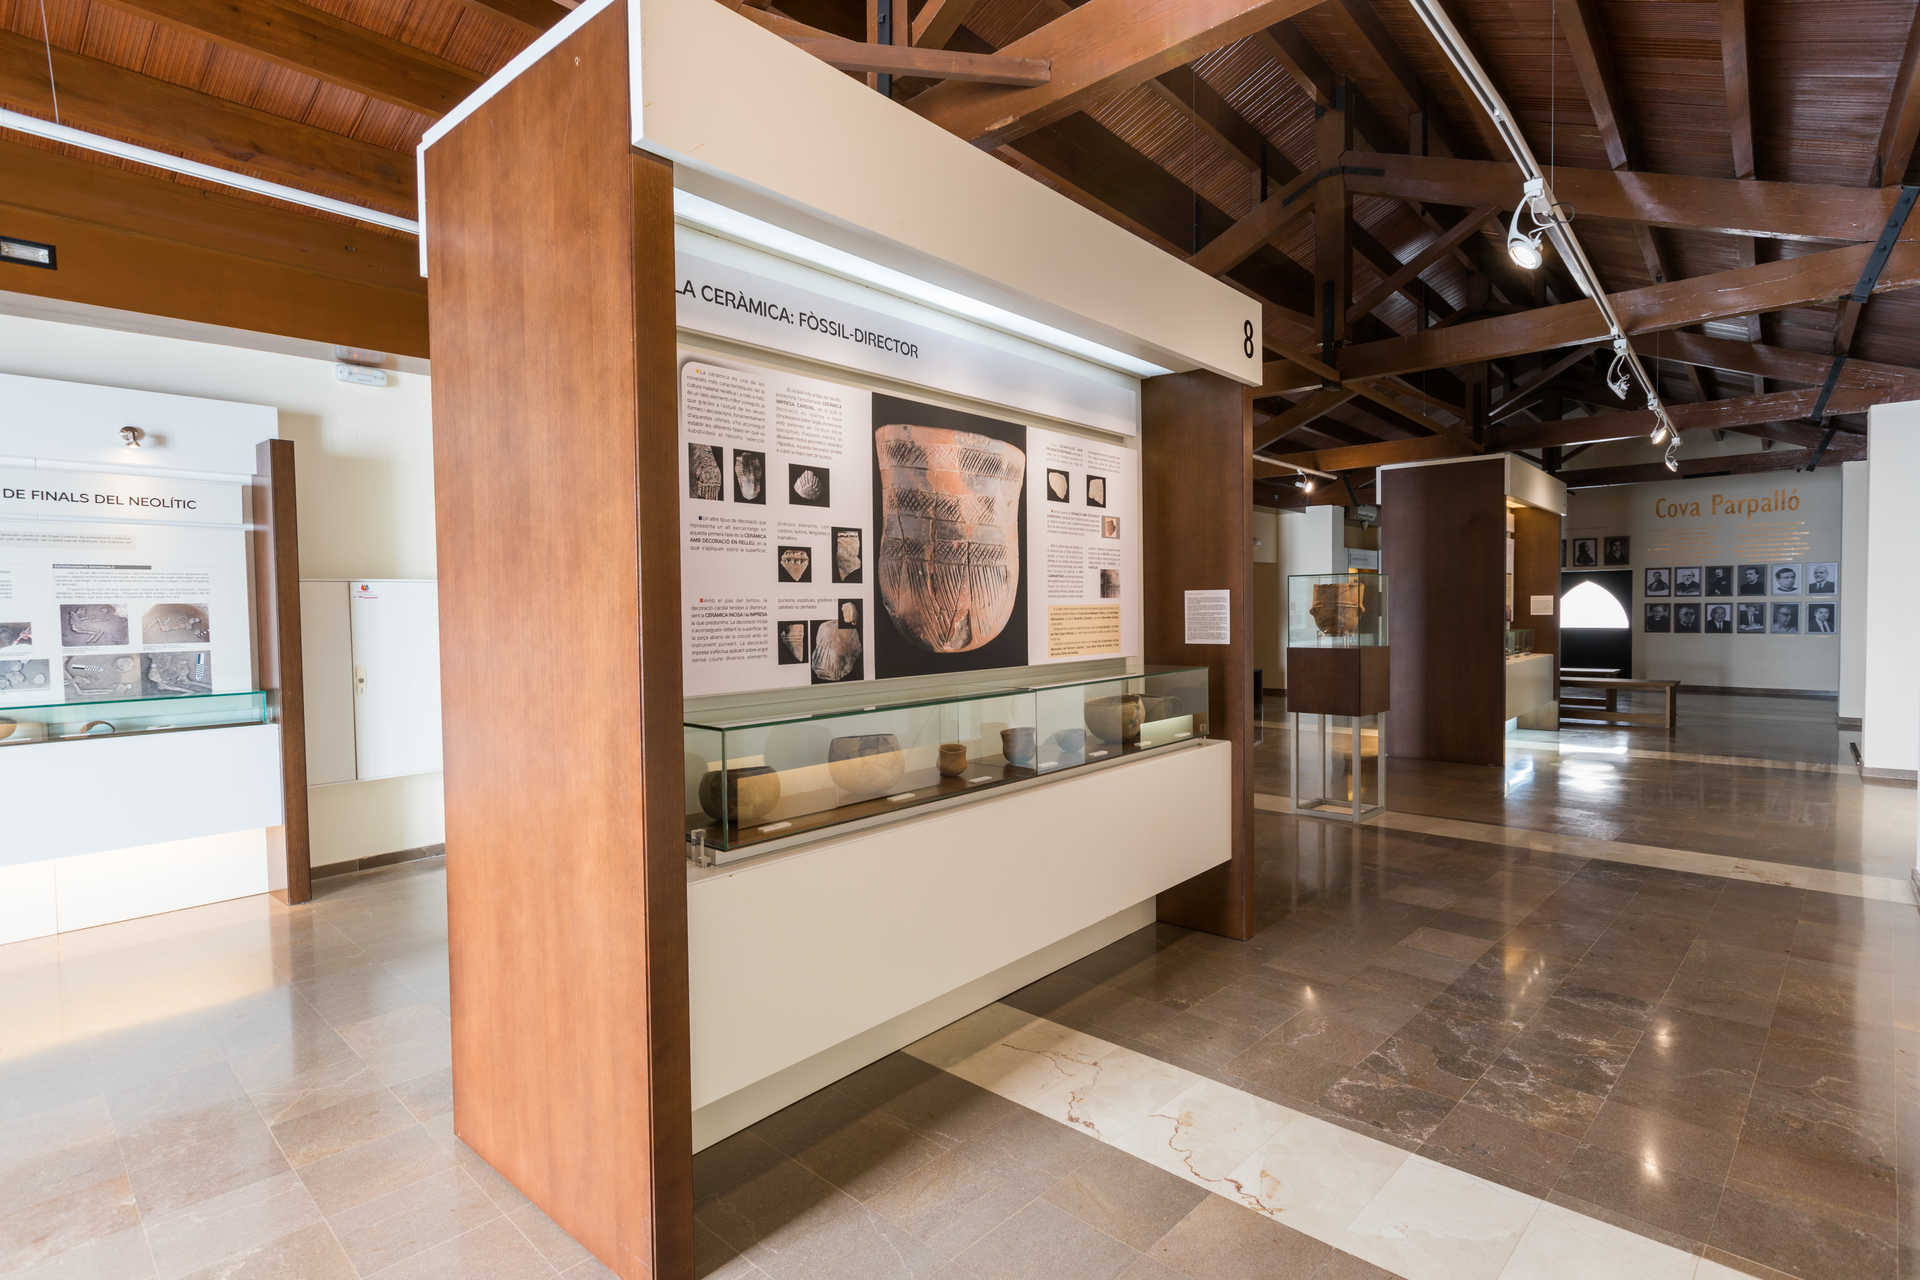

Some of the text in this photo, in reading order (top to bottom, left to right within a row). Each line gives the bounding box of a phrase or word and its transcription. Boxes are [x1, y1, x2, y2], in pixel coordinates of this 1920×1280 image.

[701, 284, 794, 325] CERÀMICA:
[799, 311, 919, 359] FÒSSIL-DIRECTOR
[1243, 320, 1254, 358] 8
[3, 488, 197, 510] DE FINALS DEL NEOLÍTIC
[1655, 488, 1800, 520] Cova Parpalló
